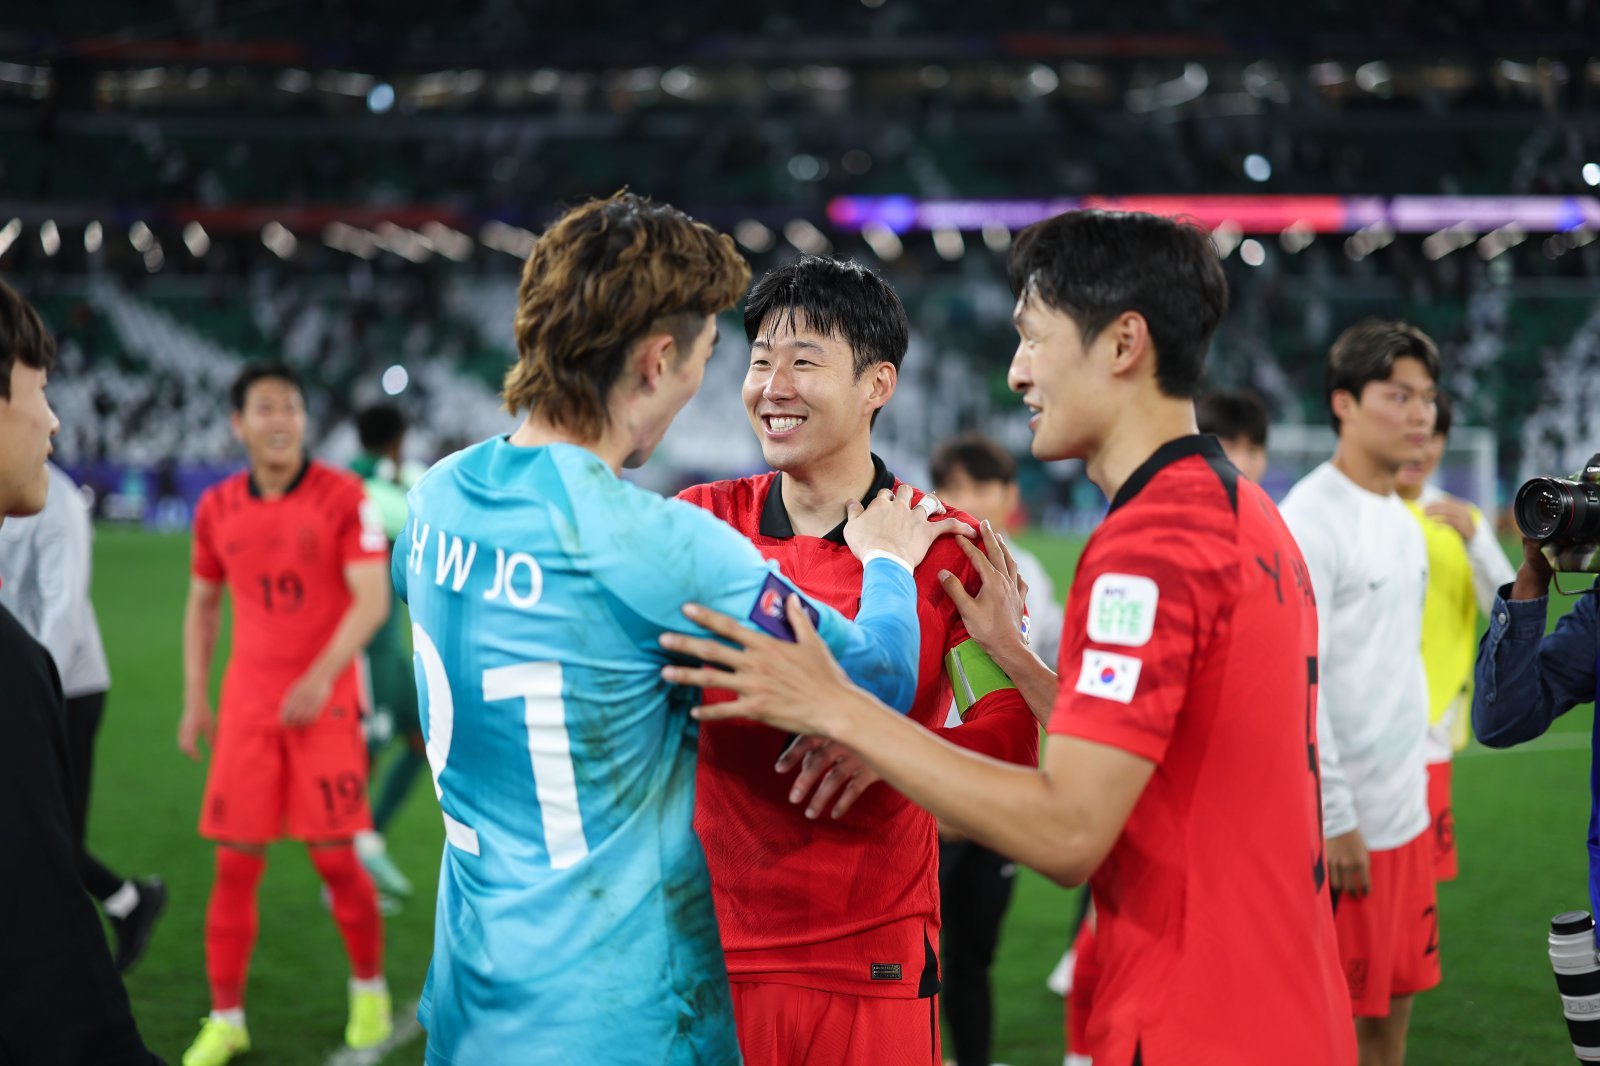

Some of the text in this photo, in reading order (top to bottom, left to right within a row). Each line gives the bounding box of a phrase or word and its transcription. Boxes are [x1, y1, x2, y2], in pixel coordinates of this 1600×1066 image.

[409, 517, 543, 609] H W JO
[257, 571, 304, 615] 19
[317, 770, 367, 816] 19
